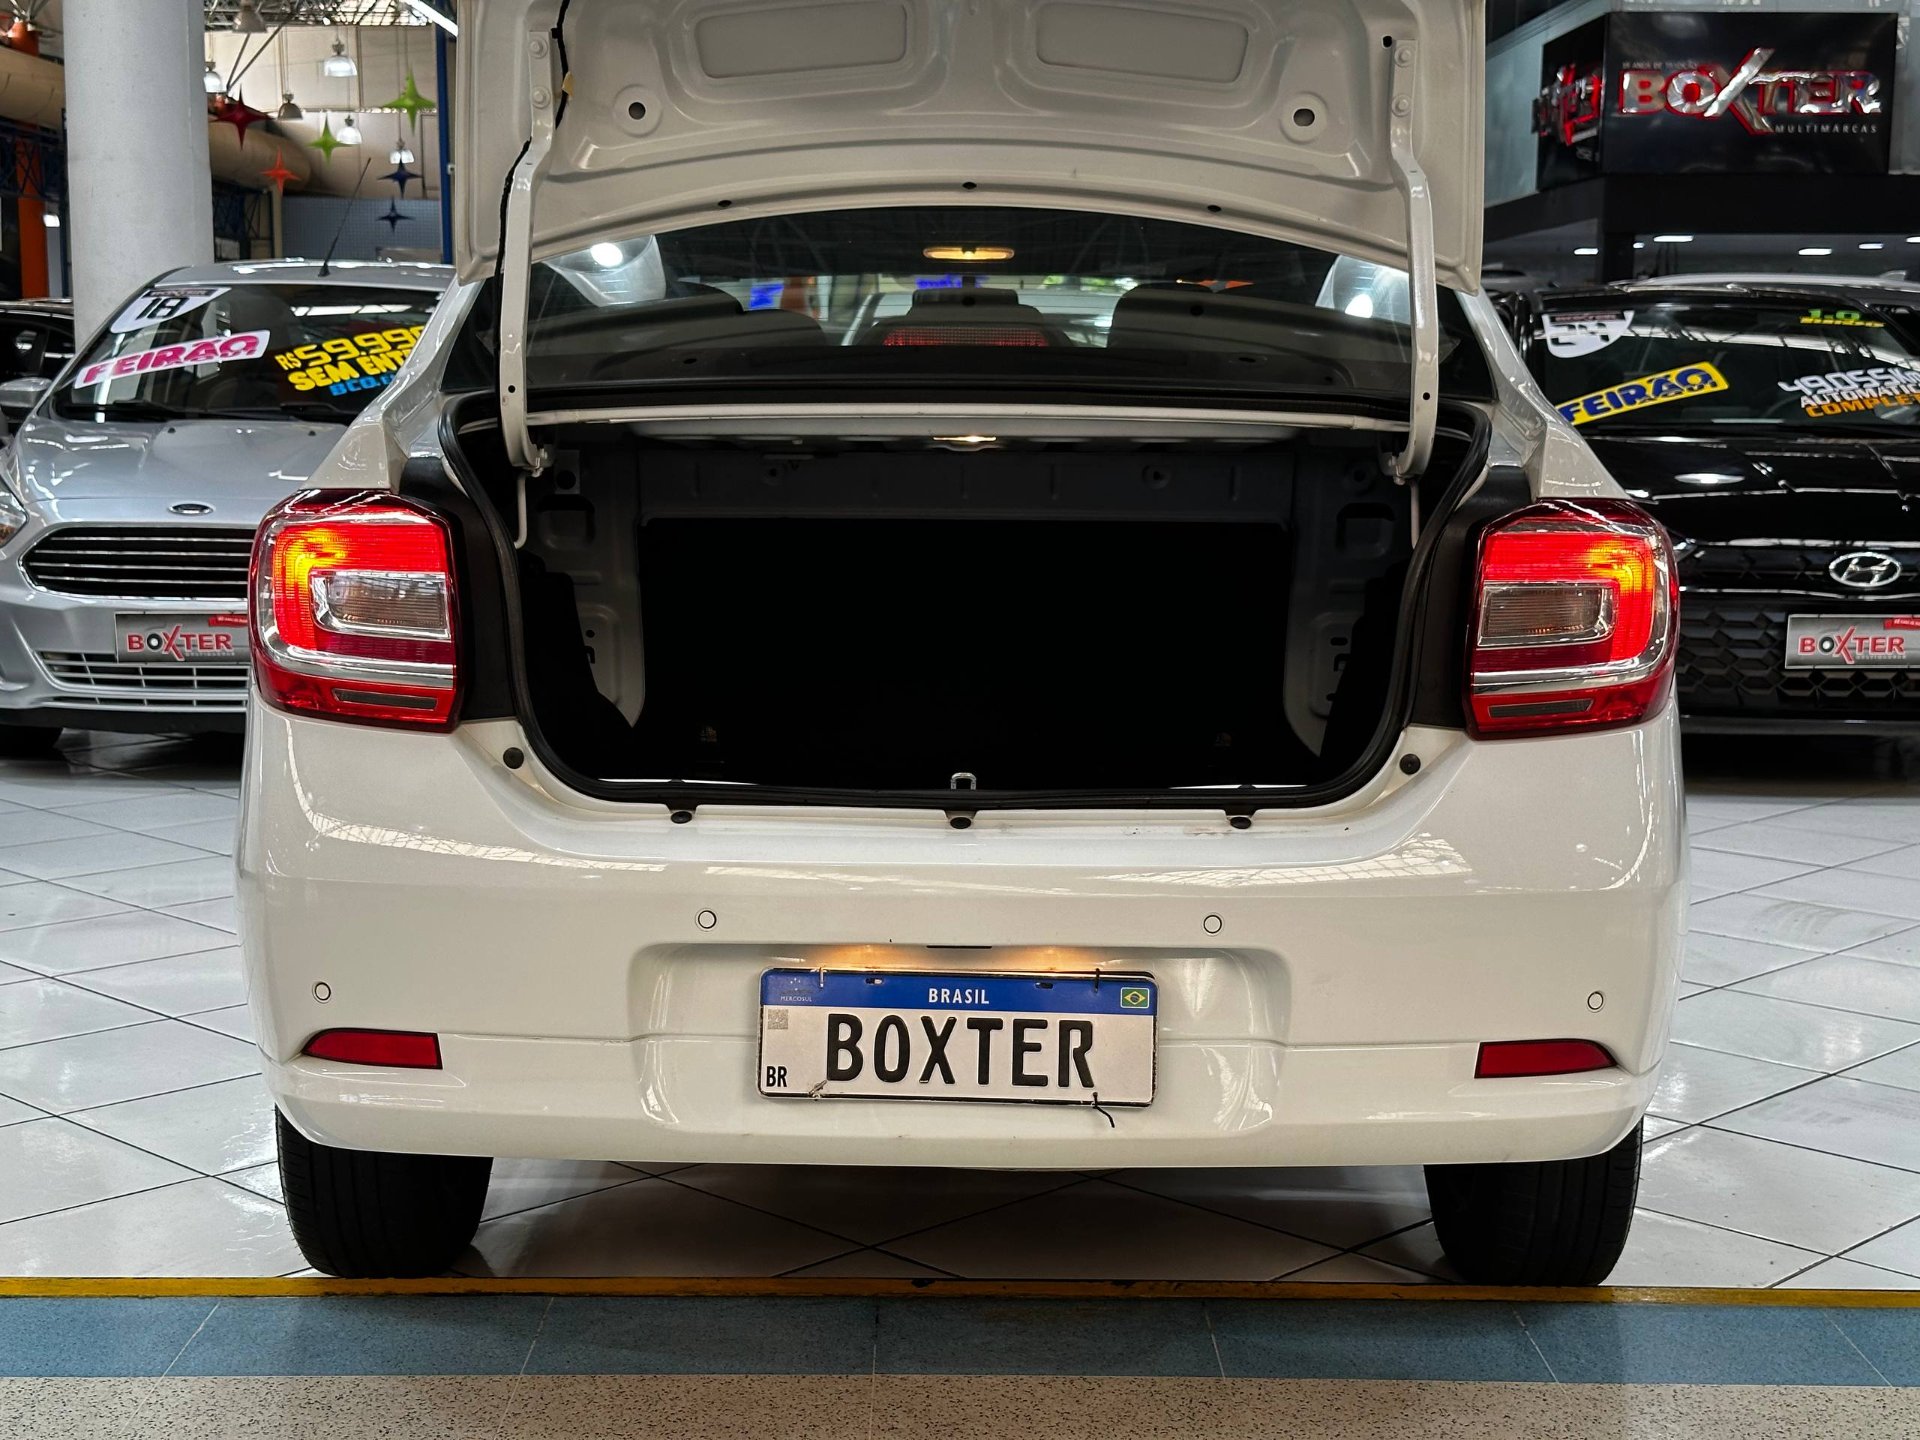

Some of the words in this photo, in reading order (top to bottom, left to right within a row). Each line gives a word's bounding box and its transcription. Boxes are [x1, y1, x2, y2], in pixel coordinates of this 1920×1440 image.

[1619, 48, 1882, 135] BOXTER
[1775, 123, 1878, 134] MULTIMARCAS
[134, 296, 190, 321] 18
[83, 335, 259, 384] FEIRÃO
[288, 360, 359, 391] SEM
[1557, 368, 1717, 422] FEIRÃO
[1801, 381, 1920, 408] AUTOMATIC
[127, 624, 234, 661] BOXTER
[1798, 626, 1906, 664] BOXTER
[928, 988, 990, 1005] BRASIL
[826, 1013, 1095, 1088] BOXTER
[766, 1065, 788, 1088] BR
